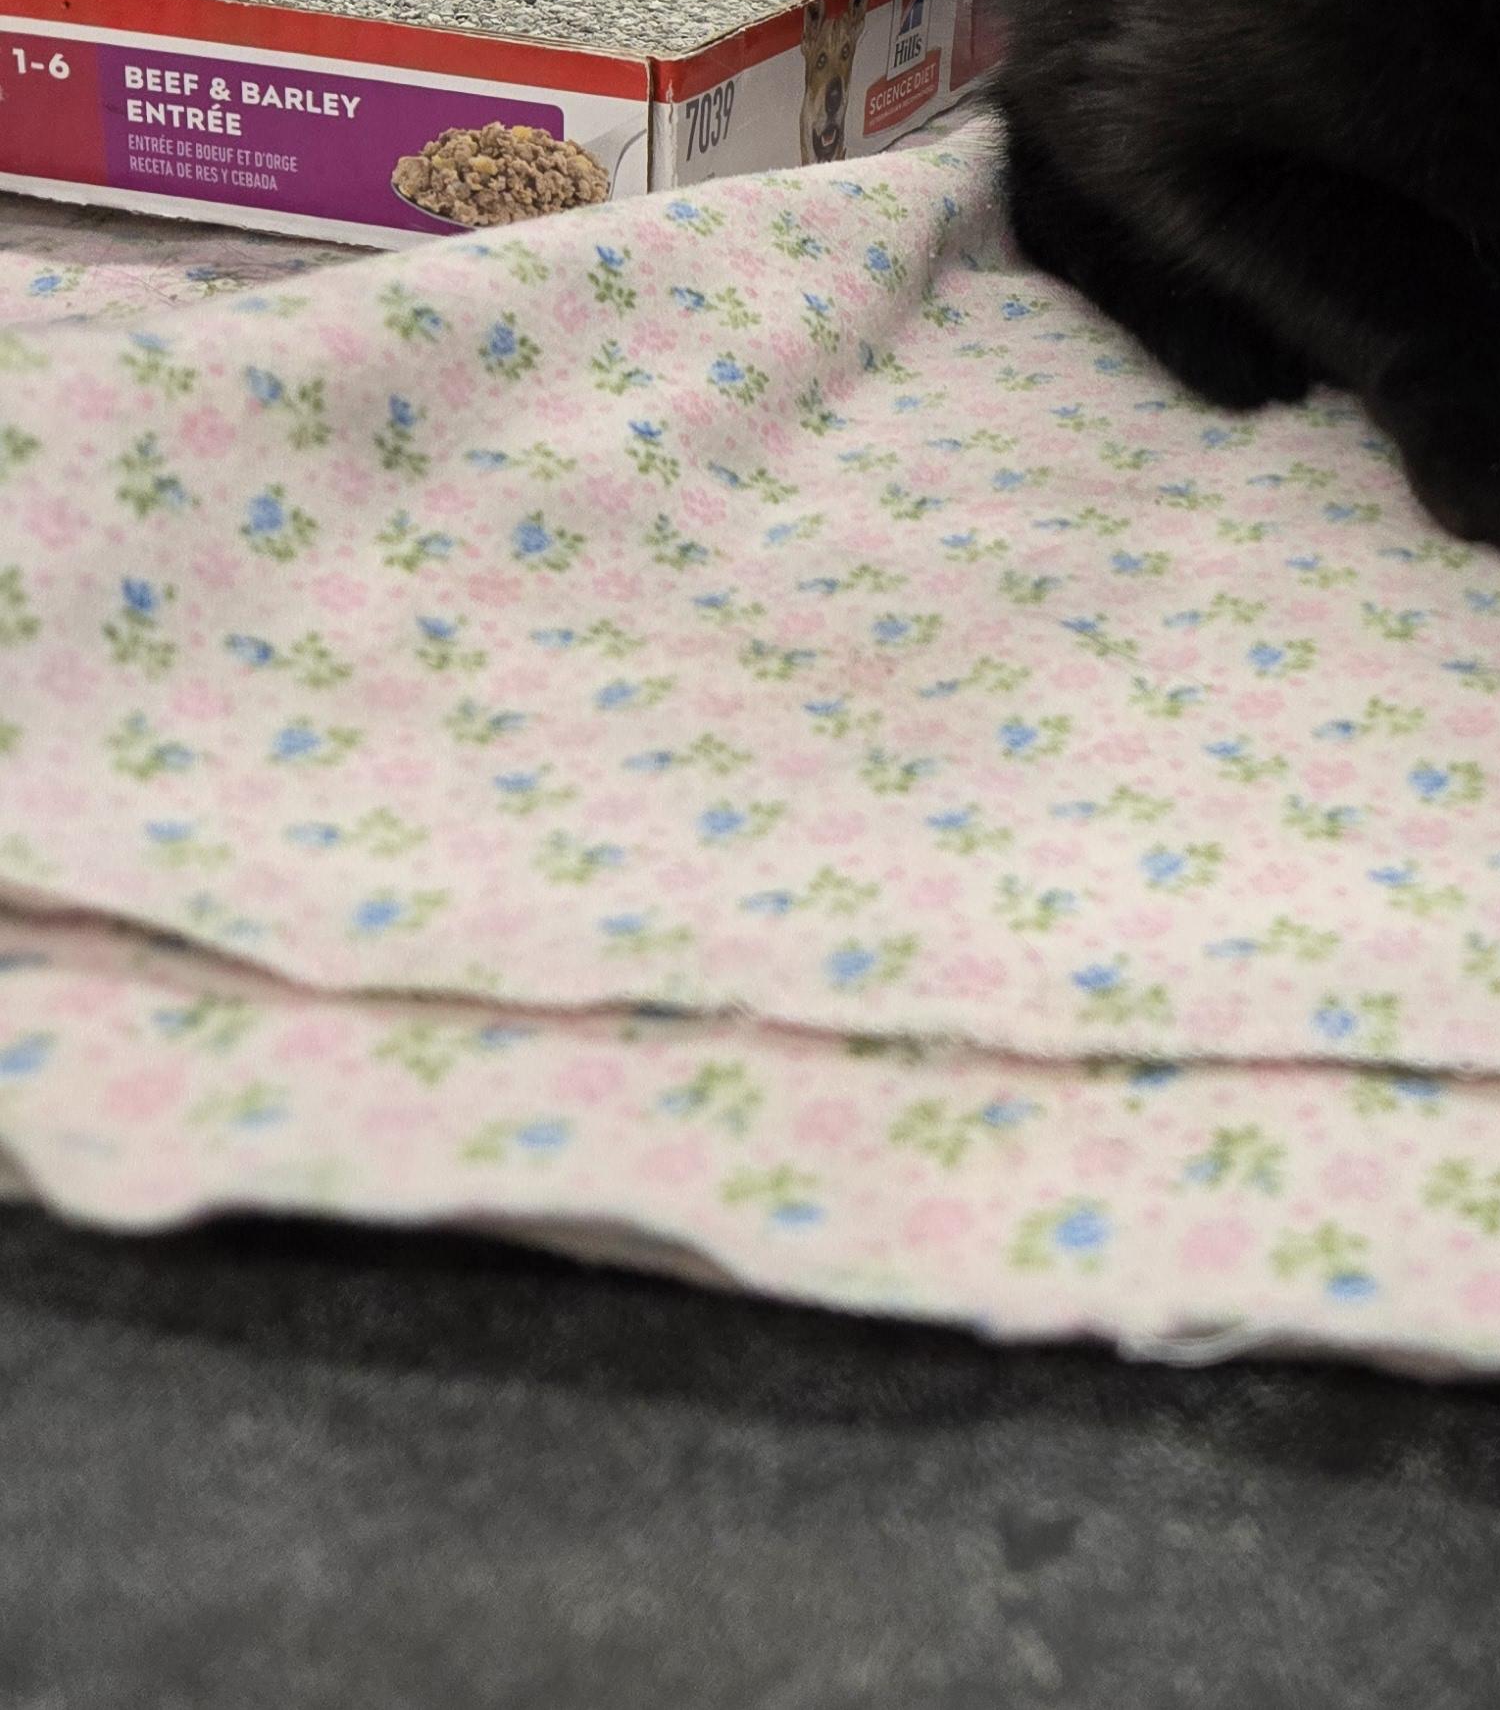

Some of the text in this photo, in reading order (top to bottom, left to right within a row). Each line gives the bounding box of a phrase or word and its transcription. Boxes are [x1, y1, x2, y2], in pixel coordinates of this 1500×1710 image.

[12, 47, 70, 79] 1-6
[892, 33, 922, 68] Hill's
[124, 66, 361, 118] BEEF & BARLEY
[869, 75, 913, 115] SCIENCE
[914, 63, 936, 89] DIET
[127, 99, 242, 136] ENTRÉE
[685, 81, 735, 162] 7039
[128, 134, 299, 173] ENTRÉE DE BOEUF ET D'ORGE
[129, 155, 278, 190] RECETA DE RES Y CEBADA
